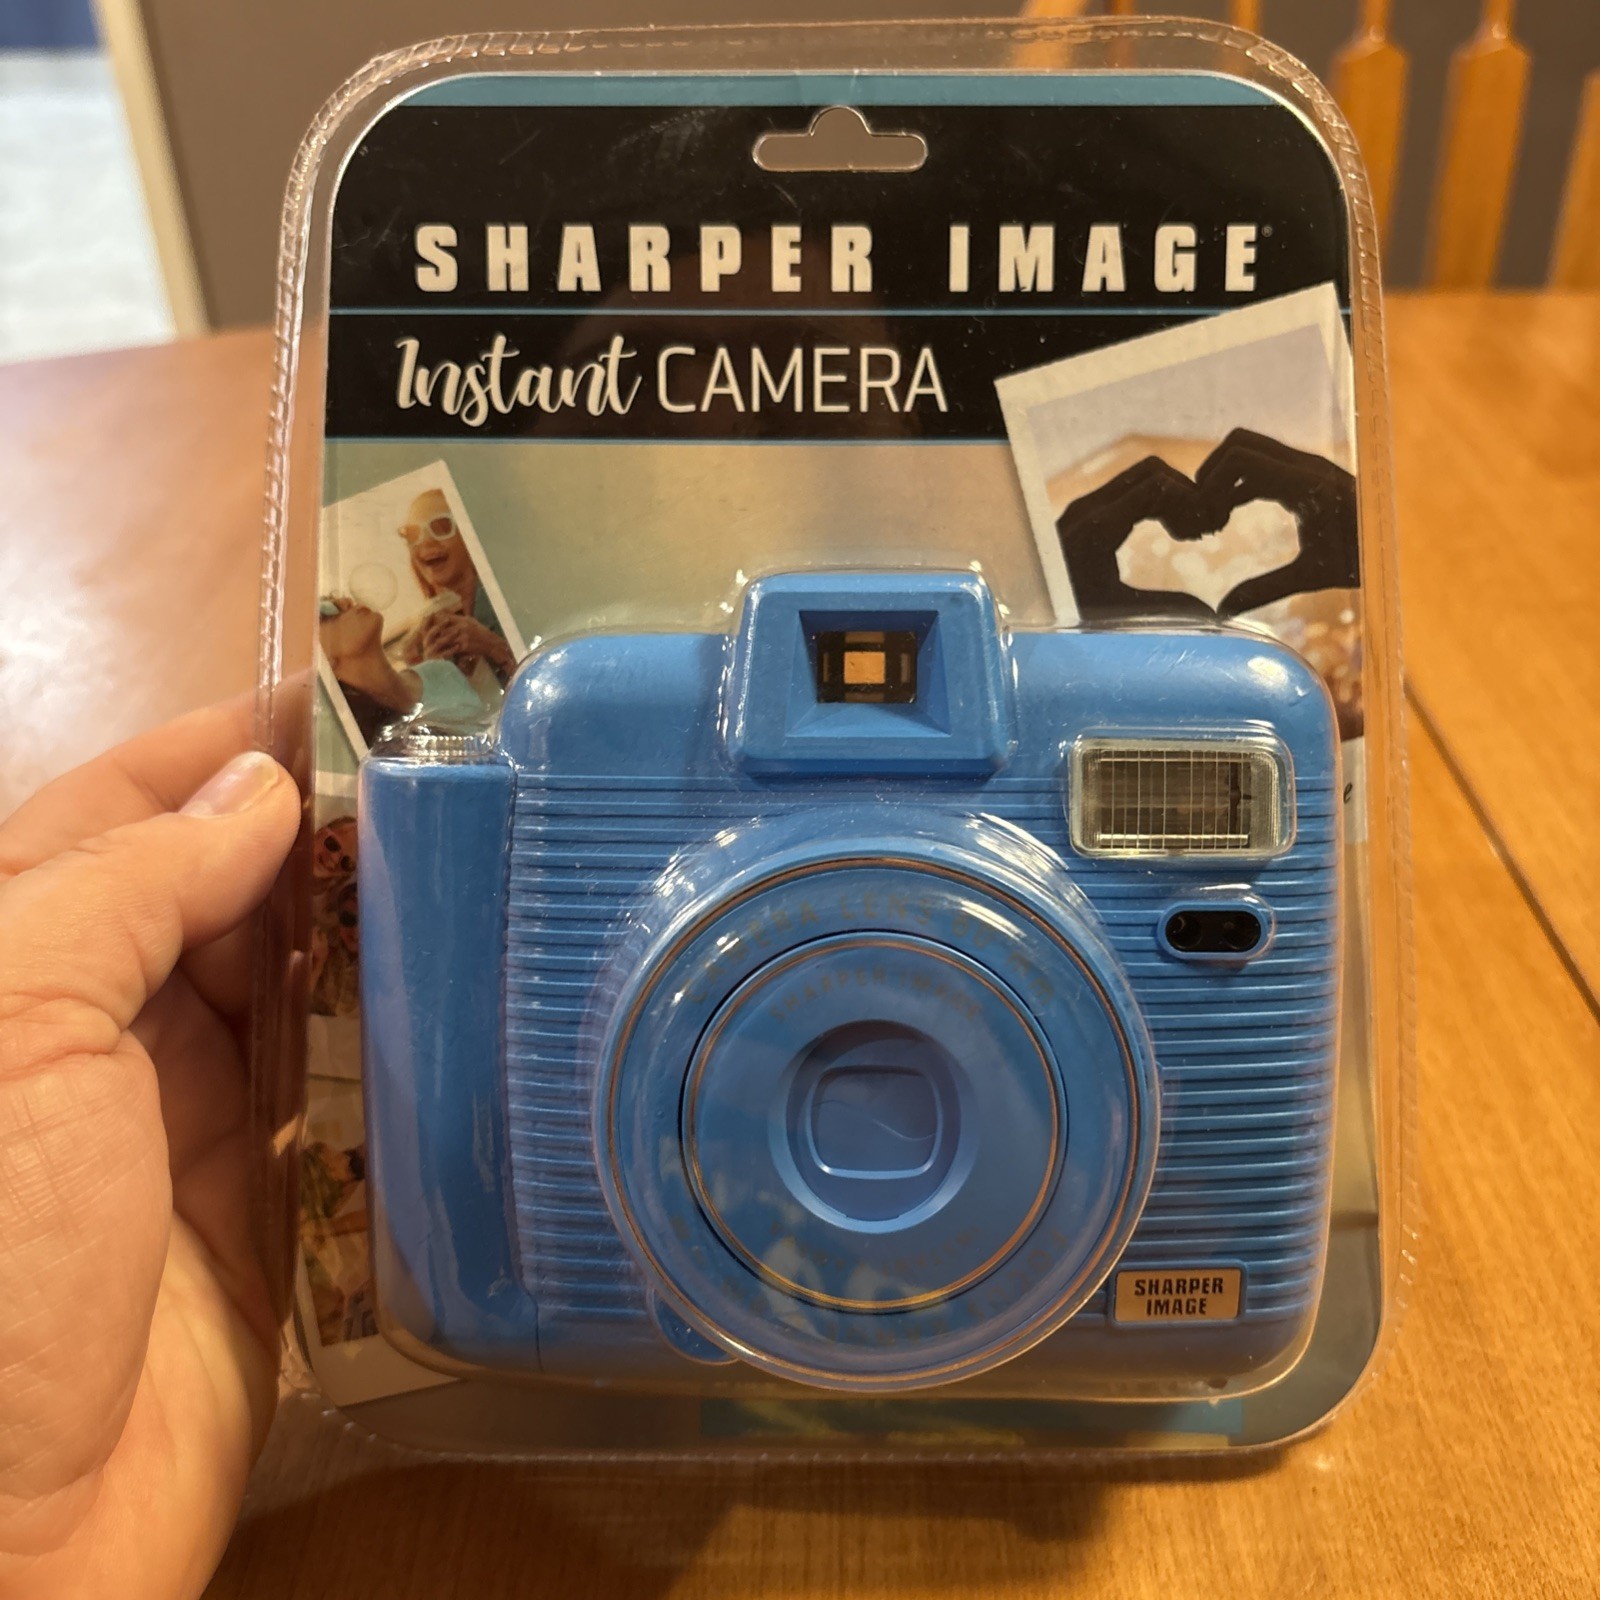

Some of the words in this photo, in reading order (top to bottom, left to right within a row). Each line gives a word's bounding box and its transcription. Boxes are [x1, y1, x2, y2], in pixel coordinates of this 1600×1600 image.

[415, 225, 874, 293] SHARPER
[949, 224, 1258, 292] IMAGE
[396, 335, 642, 427] Instant
[657, 346, 948, 413] CAMERA
[769, 965, 886, 1024] SHARPER
[1134, 1277, 1223, 1296] SHARPER
[1146, 1298, 1207, 1316] IMAGE
